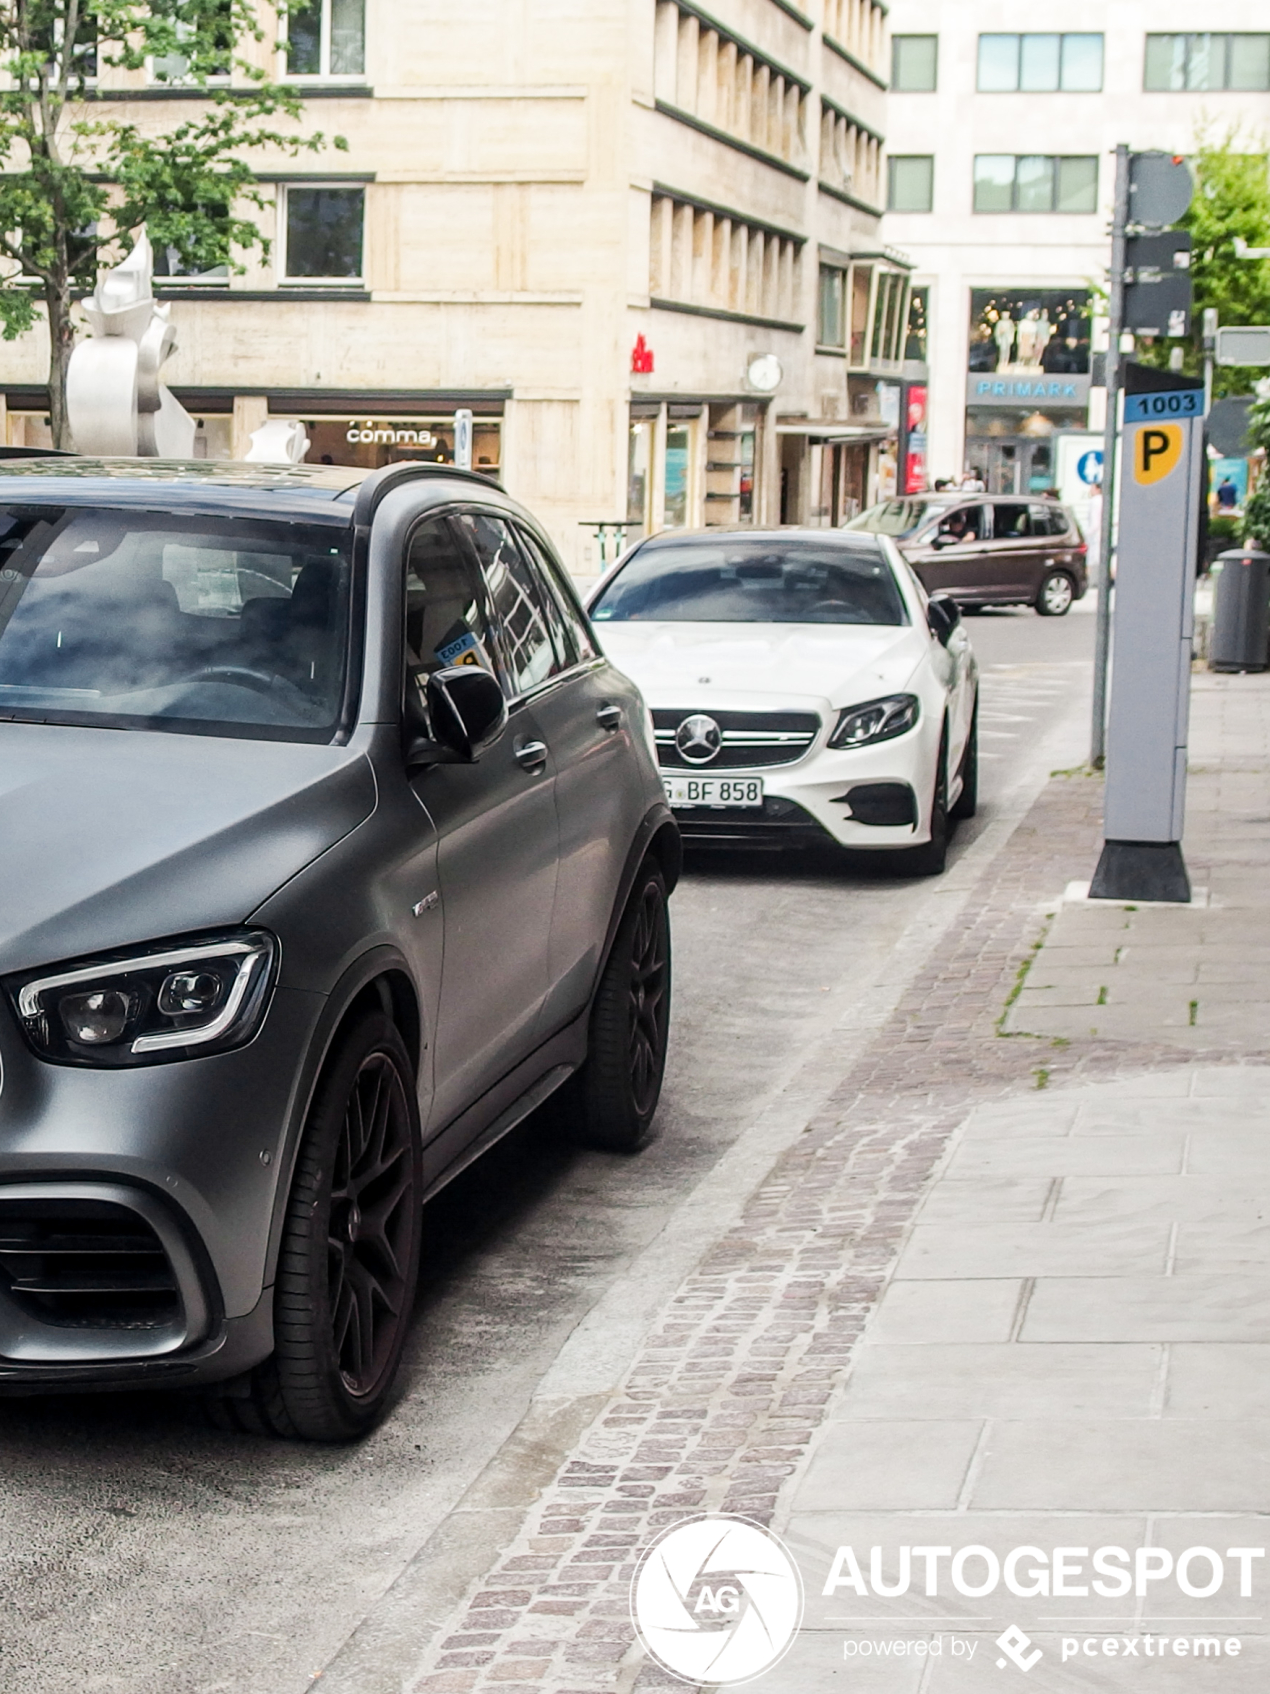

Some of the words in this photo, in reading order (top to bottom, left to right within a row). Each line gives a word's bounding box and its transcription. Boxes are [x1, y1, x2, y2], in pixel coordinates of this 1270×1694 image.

[977, 381, 1076, 398] PRIMARK
[1138, 394, 1197, 415] 1003
[347, 429, 437, 447] comma,
[1142, 430, 1170, 472] P
[687, 781, 714, 801] BF
[719, 781, 758, 801] 858
